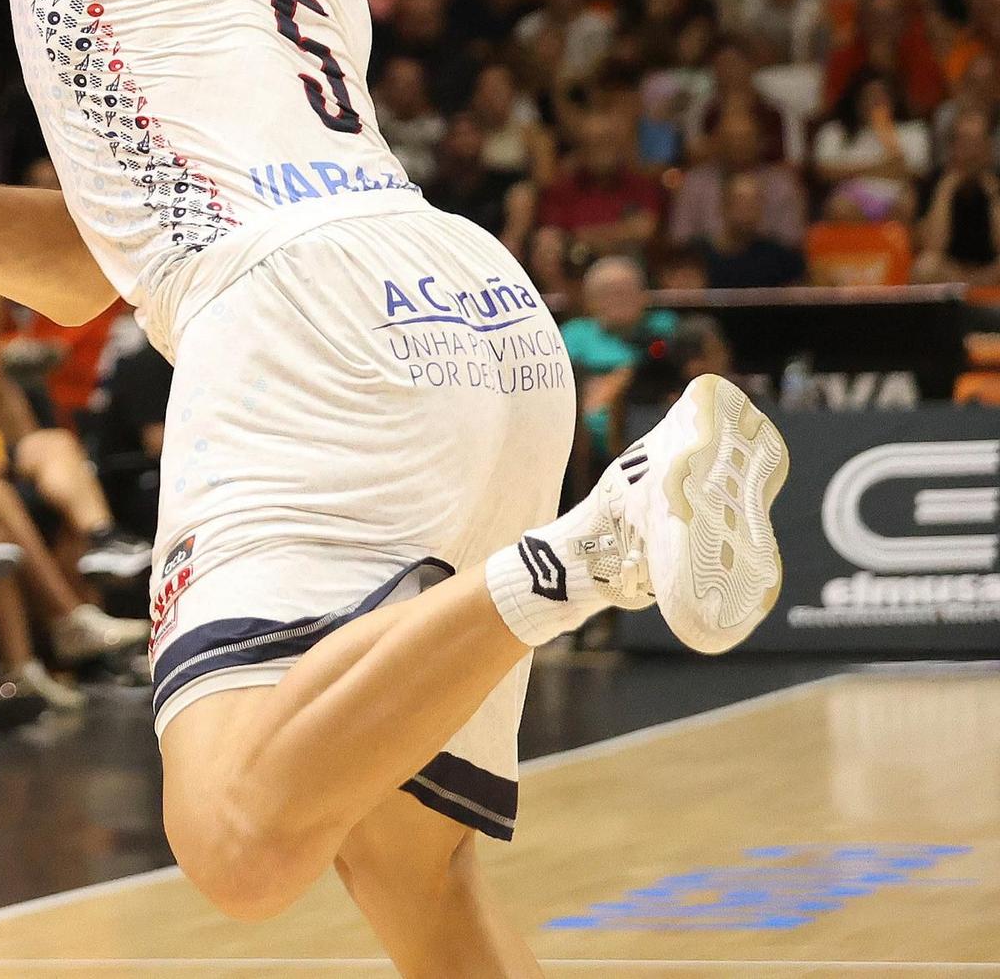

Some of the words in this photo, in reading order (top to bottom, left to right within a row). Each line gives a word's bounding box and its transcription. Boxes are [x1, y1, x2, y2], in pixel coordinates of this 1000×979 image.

[384, 279, 418, 317] A
[389, 331, 472, 361] UNHA
[409, 361, 461, 388] POR
